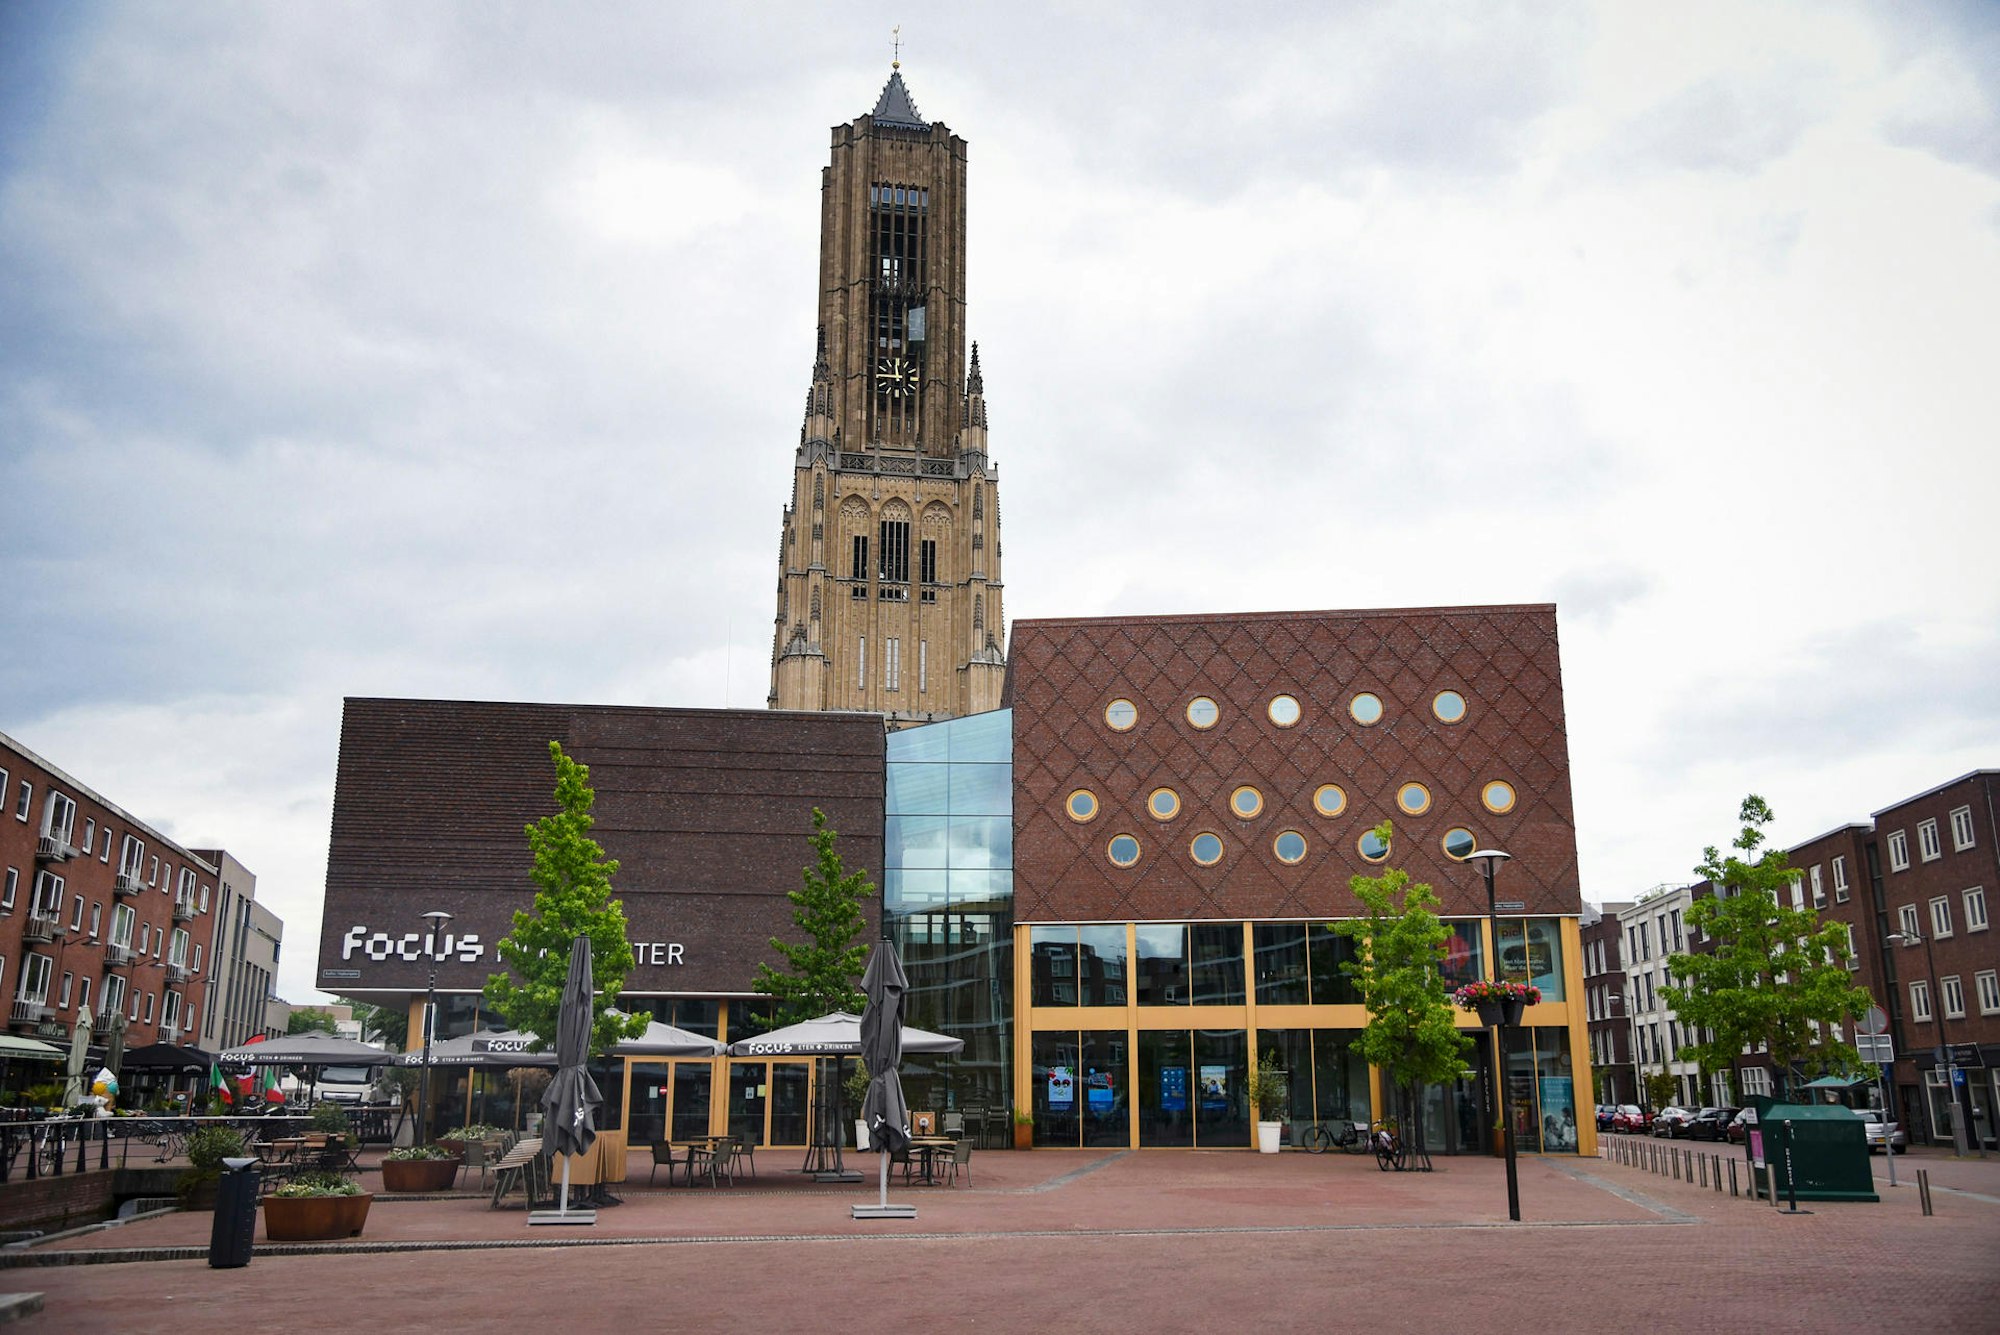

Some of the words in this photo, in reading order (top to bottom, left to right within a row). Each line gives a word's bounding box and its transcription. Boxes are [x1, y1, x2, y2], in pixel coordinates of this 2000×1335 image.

[749, 1043, 793, 1054] FOCUS
[824, 1043, 853, 1051] DRINKEN
[220, 1053, 256, 1062] FOCUS
